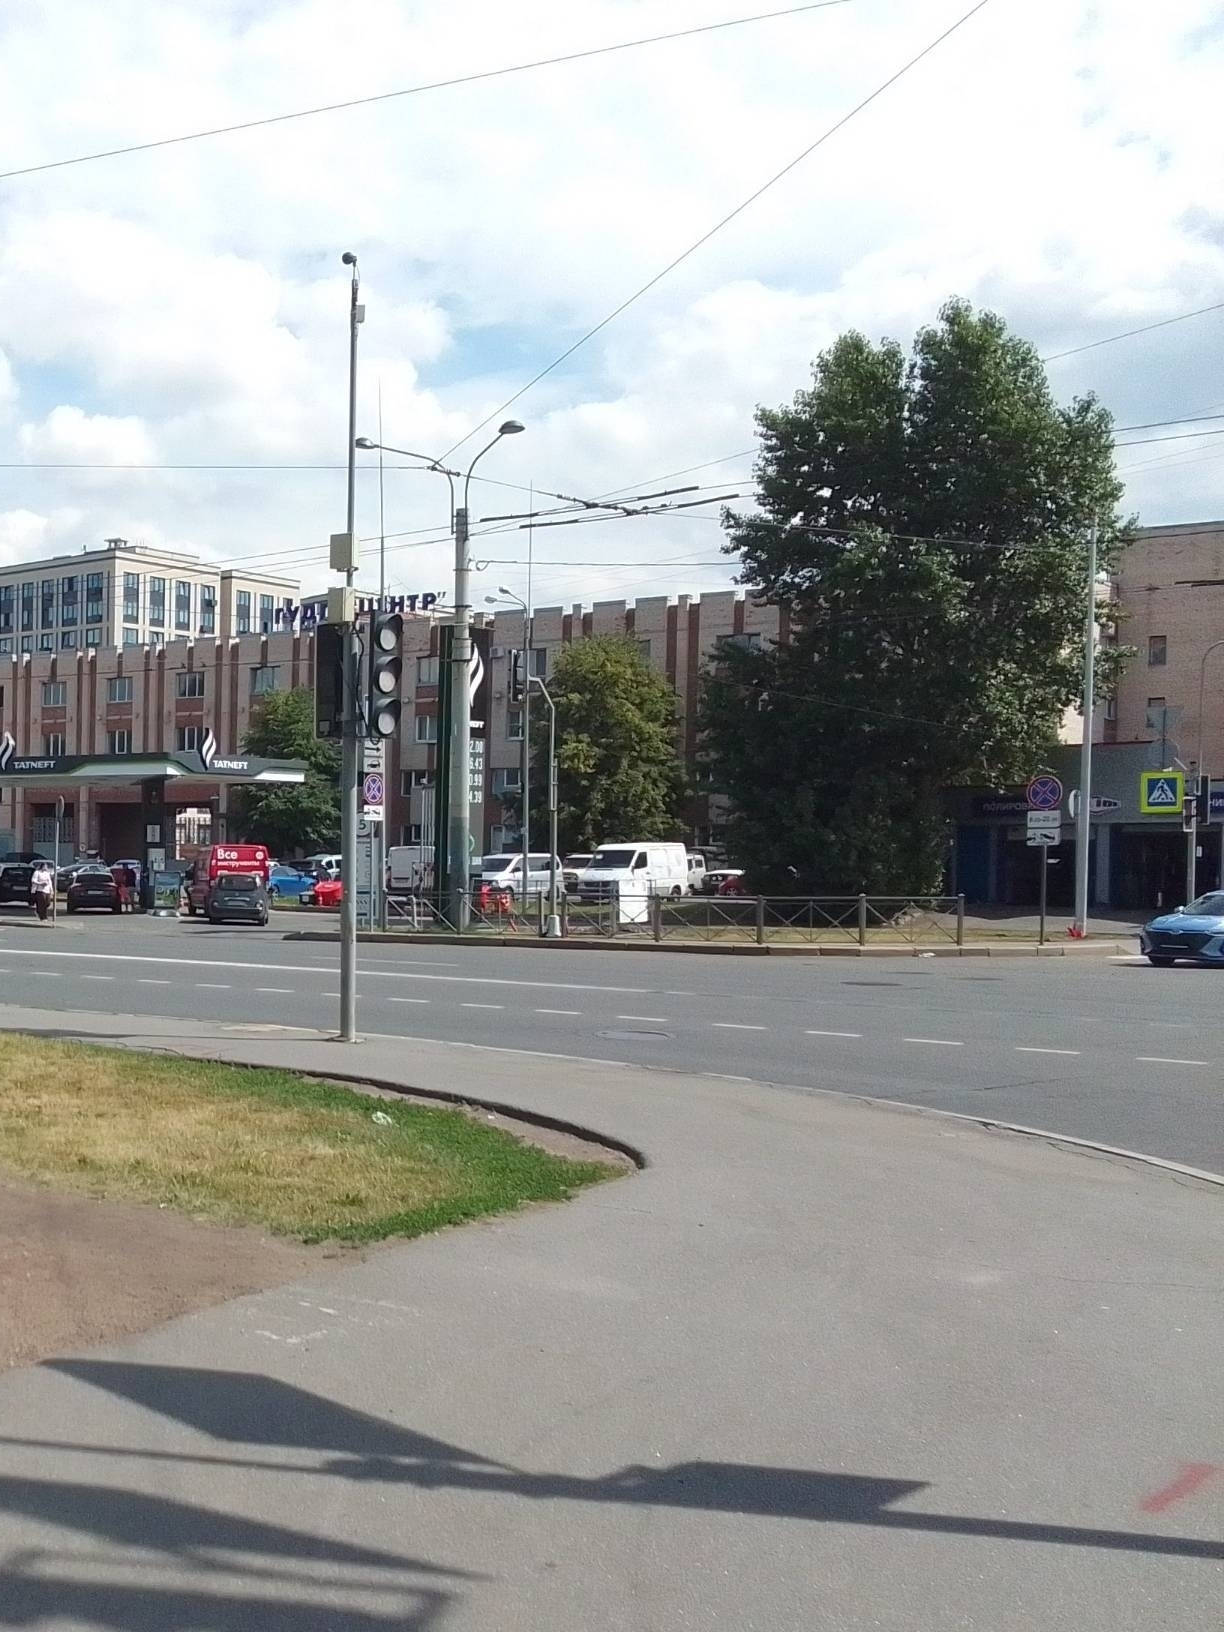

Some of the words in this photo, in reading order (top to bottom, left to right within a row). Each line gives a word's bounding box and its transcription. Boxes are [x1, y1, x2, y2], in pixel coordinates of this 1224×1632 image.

[13, 760, 56, 769] TATNEFT
[212, 760, 248, 770] TATNEFT
[217, 849, 238, 860] Все
